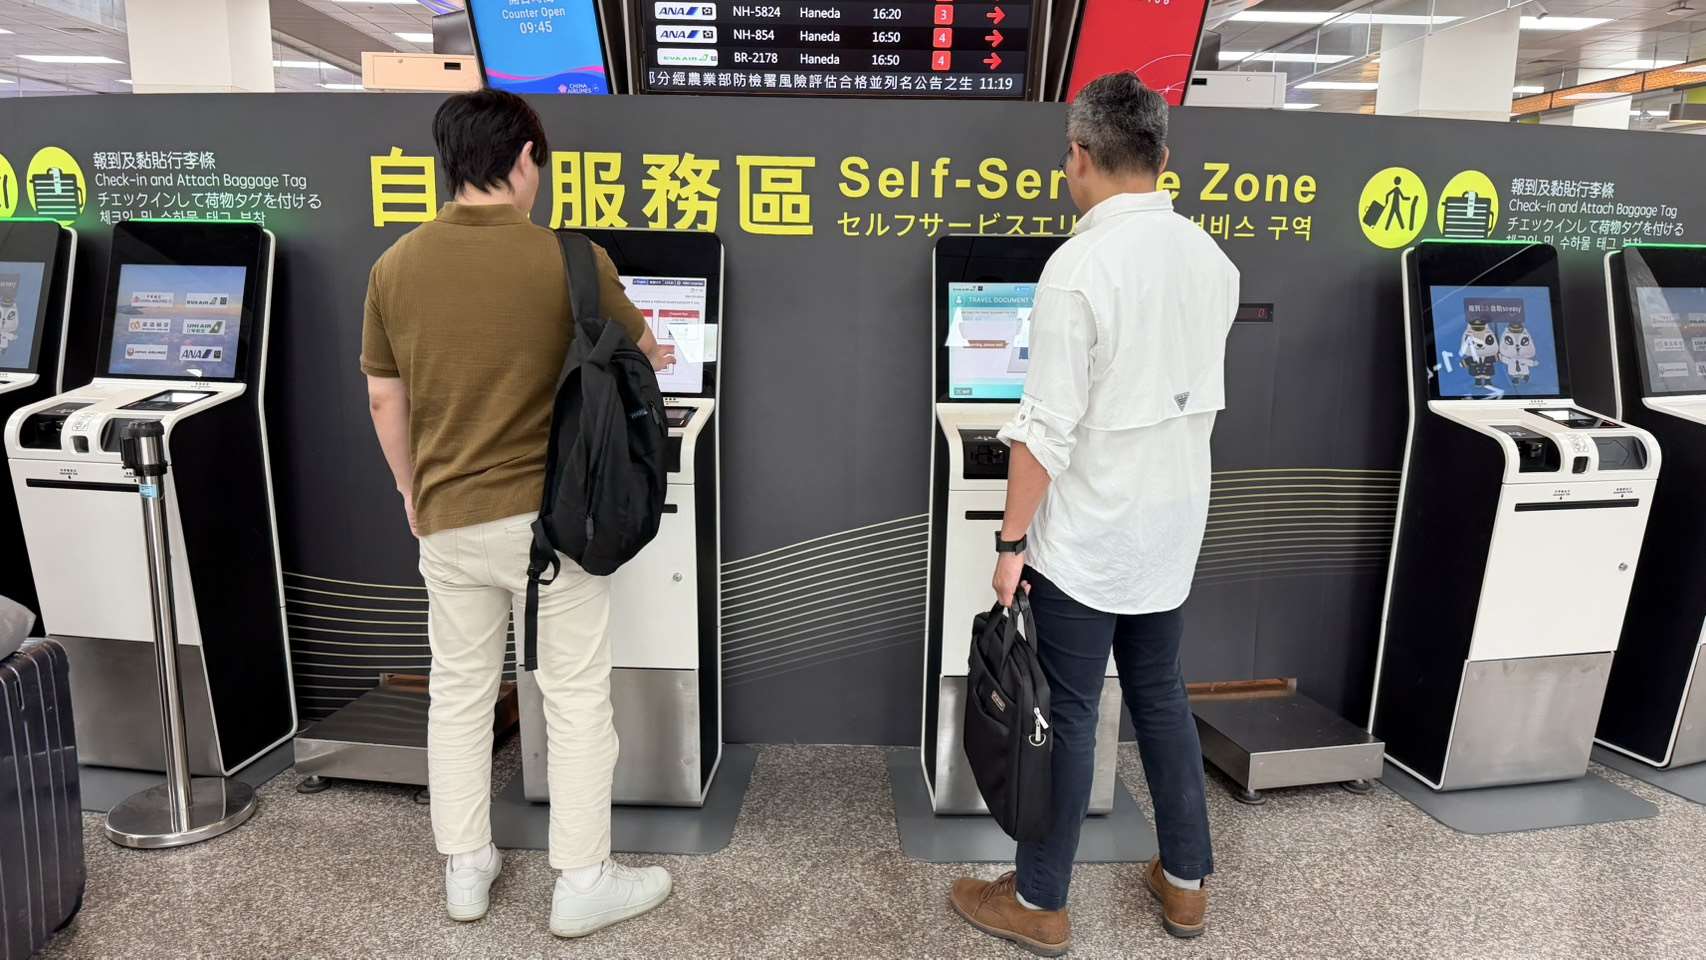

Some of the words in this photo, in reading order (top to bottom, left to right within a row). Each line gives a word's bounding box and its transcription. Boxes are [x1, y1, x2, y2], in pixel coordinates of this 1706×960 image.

[502, 9, 538, 20] Counter
[541, 7, 566, 19] Open
[659, 6, 685, 16] ANA
[732, 6, 781, 18] NH-5824
[800, 7, 841, 19] Haneda
[873, 8, 902, 20] 16:20
[940, 9, 948, 20] 3
[520, 20, 553, 34] 09:45
[660, 30, 686, 39] ANA
[733, 29, 775, 41] NH-854
[800, 30, 841, 42] Haneda
[872, 31, 901, 43] 16:50
[939, 32, 946, 43] 4
[734, 52, 778, 64] BR-2178
[800, 53, 840, 65] Haneda
[871, 54, 900, 66] 16:50
[938, 55, 945, 66] 4
[980, 77, 1013, 90] 11:19
[92, 151, 216, 170] 報到及黏貼行李條
[95, 173, 148, 187] Check-in
[150, 173, 174, 187] and
[177, 173, 220, 187] Attach
[223, 173, 280, 190] Baggage
[282, 174, 307, 190] Tag
[838, 156, 1181, 201] Self-Sere
[1200, 162, 1318, 203] Zone
[371, 146, 816, 235] 自服務區
[1511, 178, 1616, 199] 報到及黏貼行李條
[97, 191, 322, 210] チェックインして荷物タグを付ける
[1509, 198, 1556, 213] Check-in
[1558, 200, 1579, 214] and
[1580, 201, 1614, 215] Attach
[1616, 203, 1658, 218] Baggage
[1660, 204, 1678, 219] Tag
[837, 211, 1078, 237] セルフサービスエリ
[1267, 215, 1312, 241] 구역
[1507, 217, 1684, 237] チェックインして荷物タグを付ける
[968, 296, 993, 304] TRAVEL
[994, 296, 1030, 304] DOCUMENT
[182, 349, 202, 359] ANA
